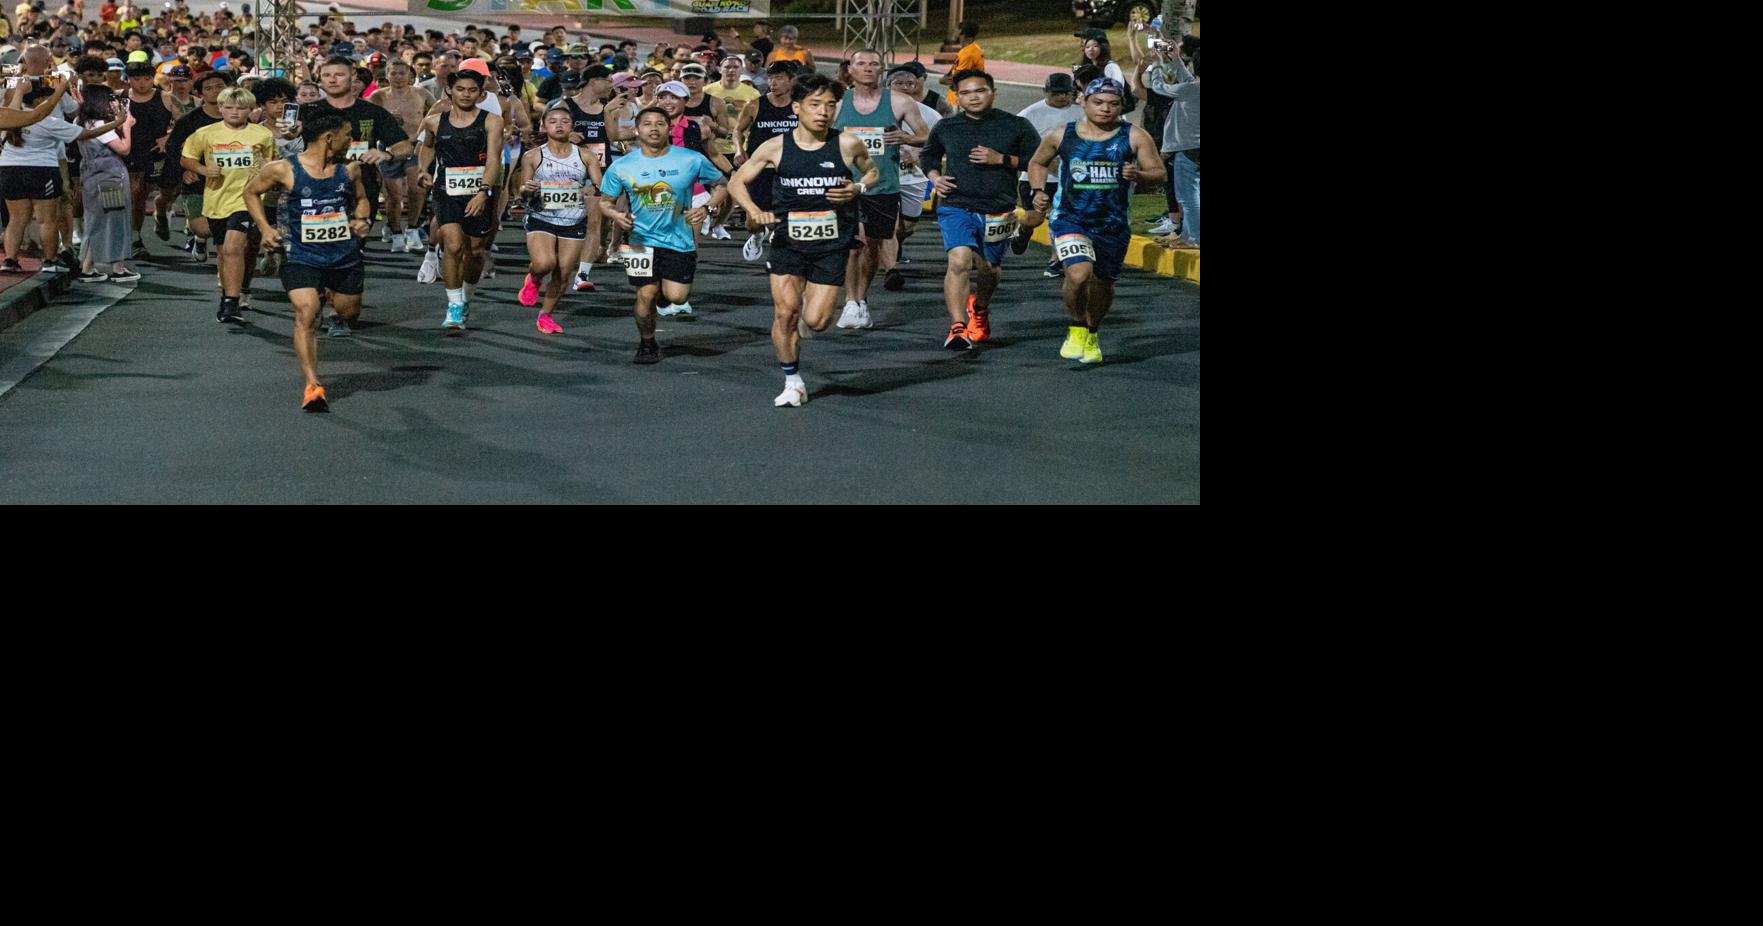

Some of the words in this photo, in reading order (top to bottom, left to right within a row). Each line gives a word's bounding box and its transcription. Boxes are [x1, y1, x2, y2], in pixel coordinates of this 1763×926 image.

[216, 156, 252, 168] 5146
[1090, 166, 1120, 178] HALF
[448, 177, 483, 189] 5426
[797, 187, 825, 195] CREW
[543, 192, 578, 203] 5024
[305, 225, 348, 241] 5282
[792, 224, 835, 239] 5245
